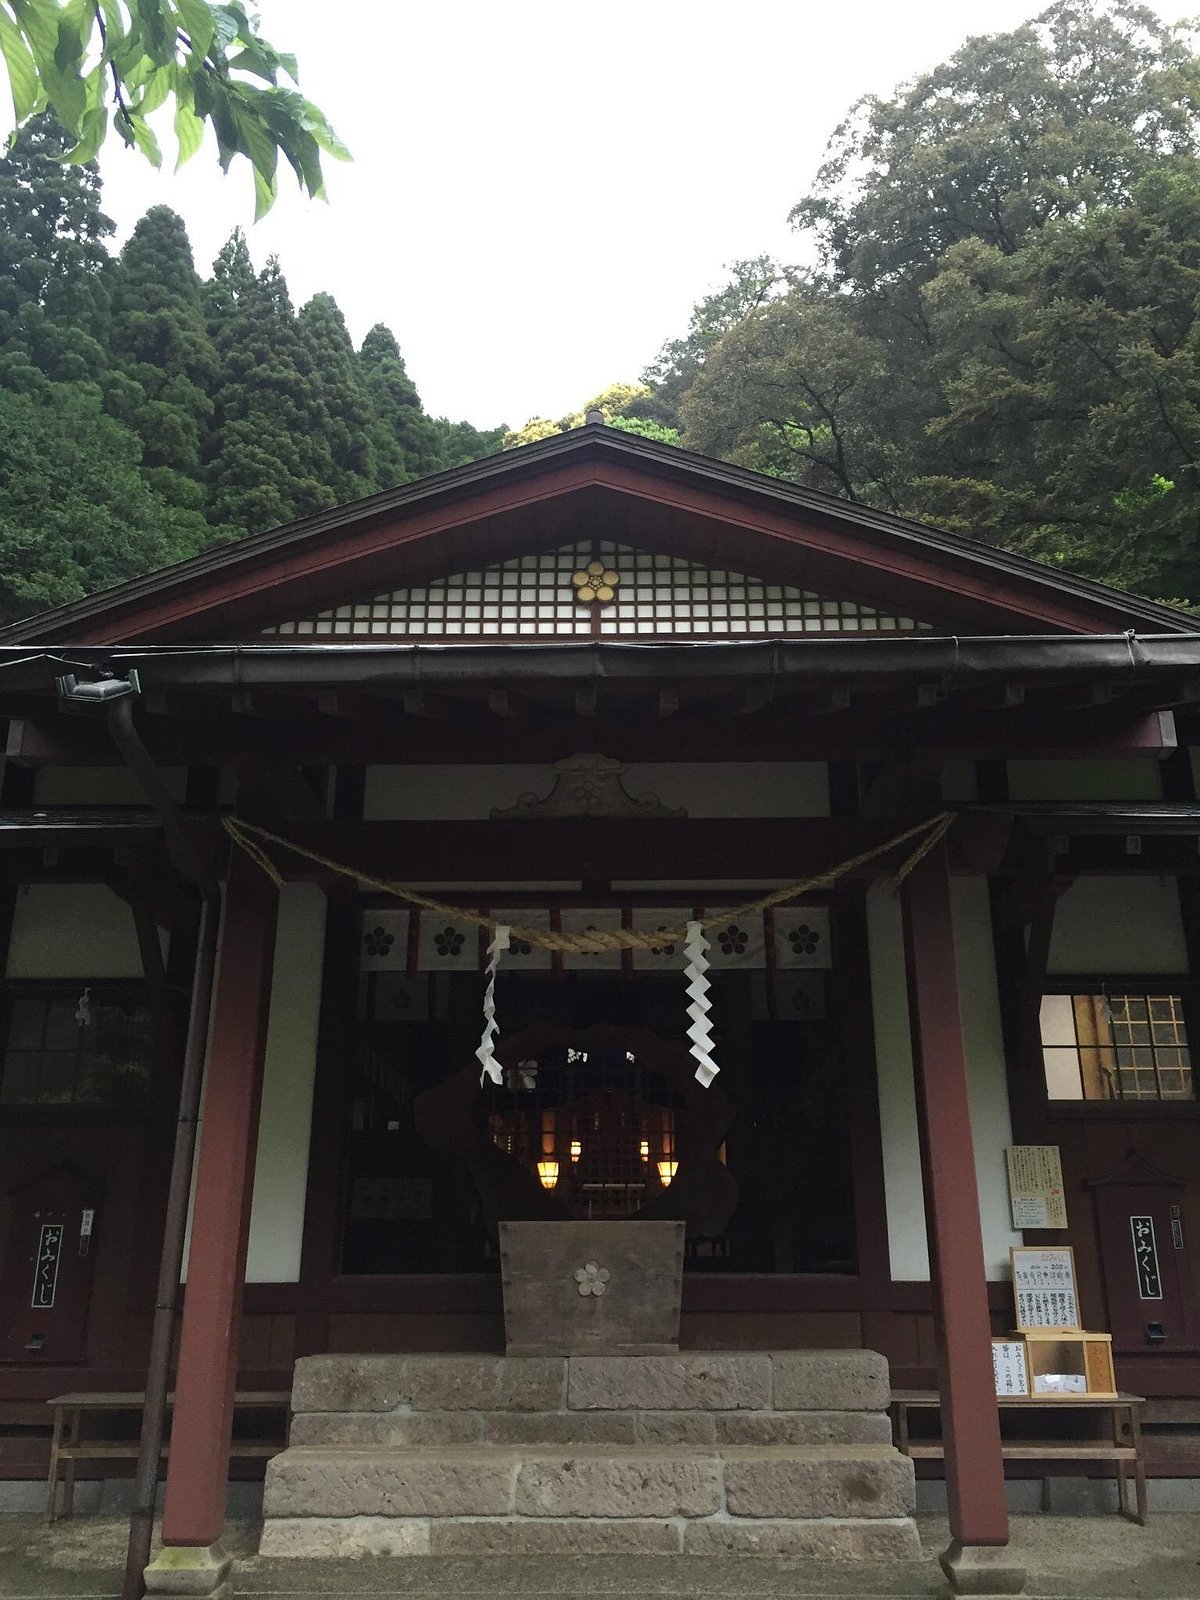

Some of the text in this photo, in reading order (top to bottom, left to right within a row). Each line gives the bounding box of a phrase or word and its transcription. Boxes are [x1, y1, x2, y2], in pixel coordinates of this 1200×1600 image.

[40, 1229, 59, 1304] おみくじ
[1136, 1221, 1157, 1295] おみくじ
